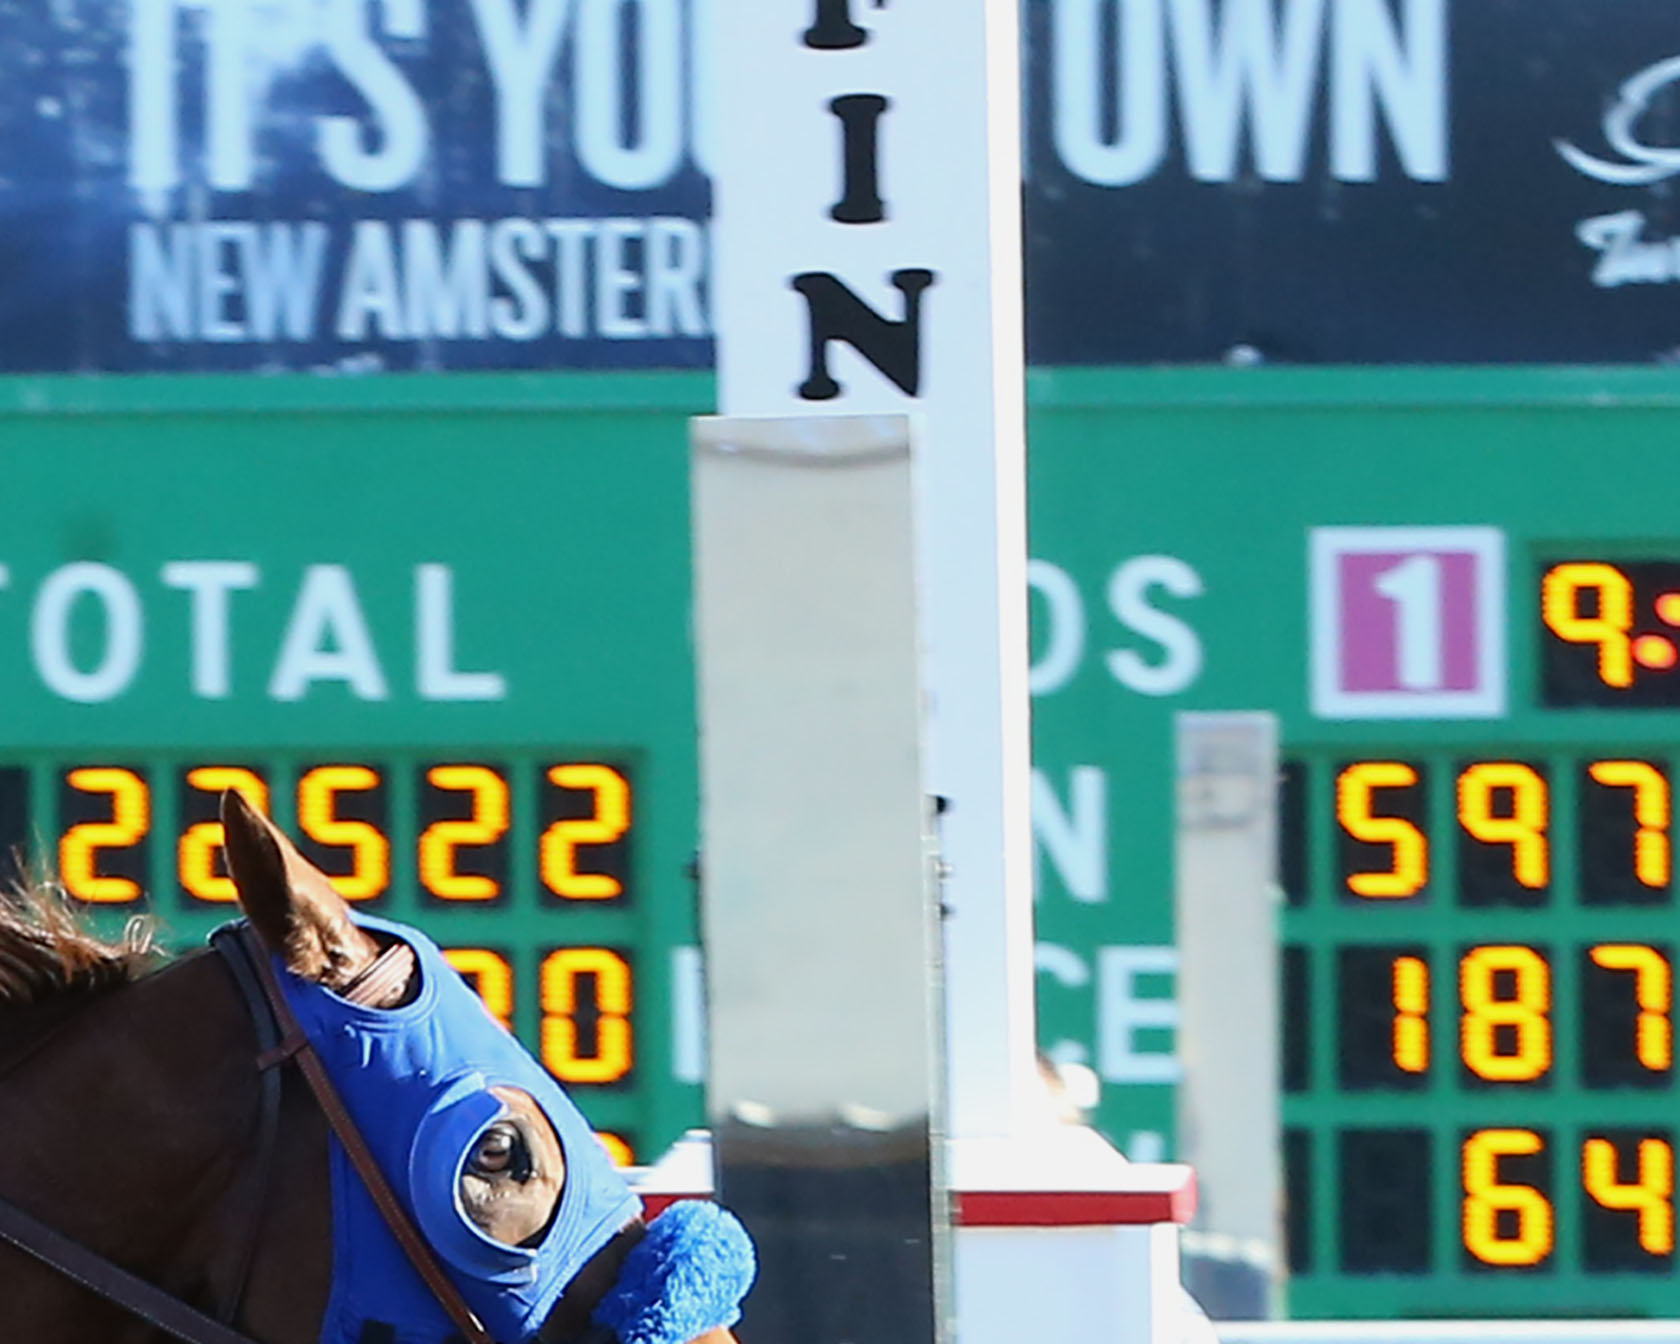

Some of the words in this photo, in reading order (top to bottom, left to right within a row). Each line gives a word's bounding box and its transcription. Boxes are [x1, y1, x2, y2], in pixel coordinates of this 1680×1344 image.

[1021, 0, 1452, 186] OWN
[129, 219, 328, 342] NEW
[338, 217, 718, 341] AMSTER
[1376, 555, 1442, 692] 1
[58, 762, 632, 903] 22522
[1337, 760, 1673, 898] 597
[1390, 944, 1673, 1083] 187
[1460, 1129, 1676, 1267] 64
